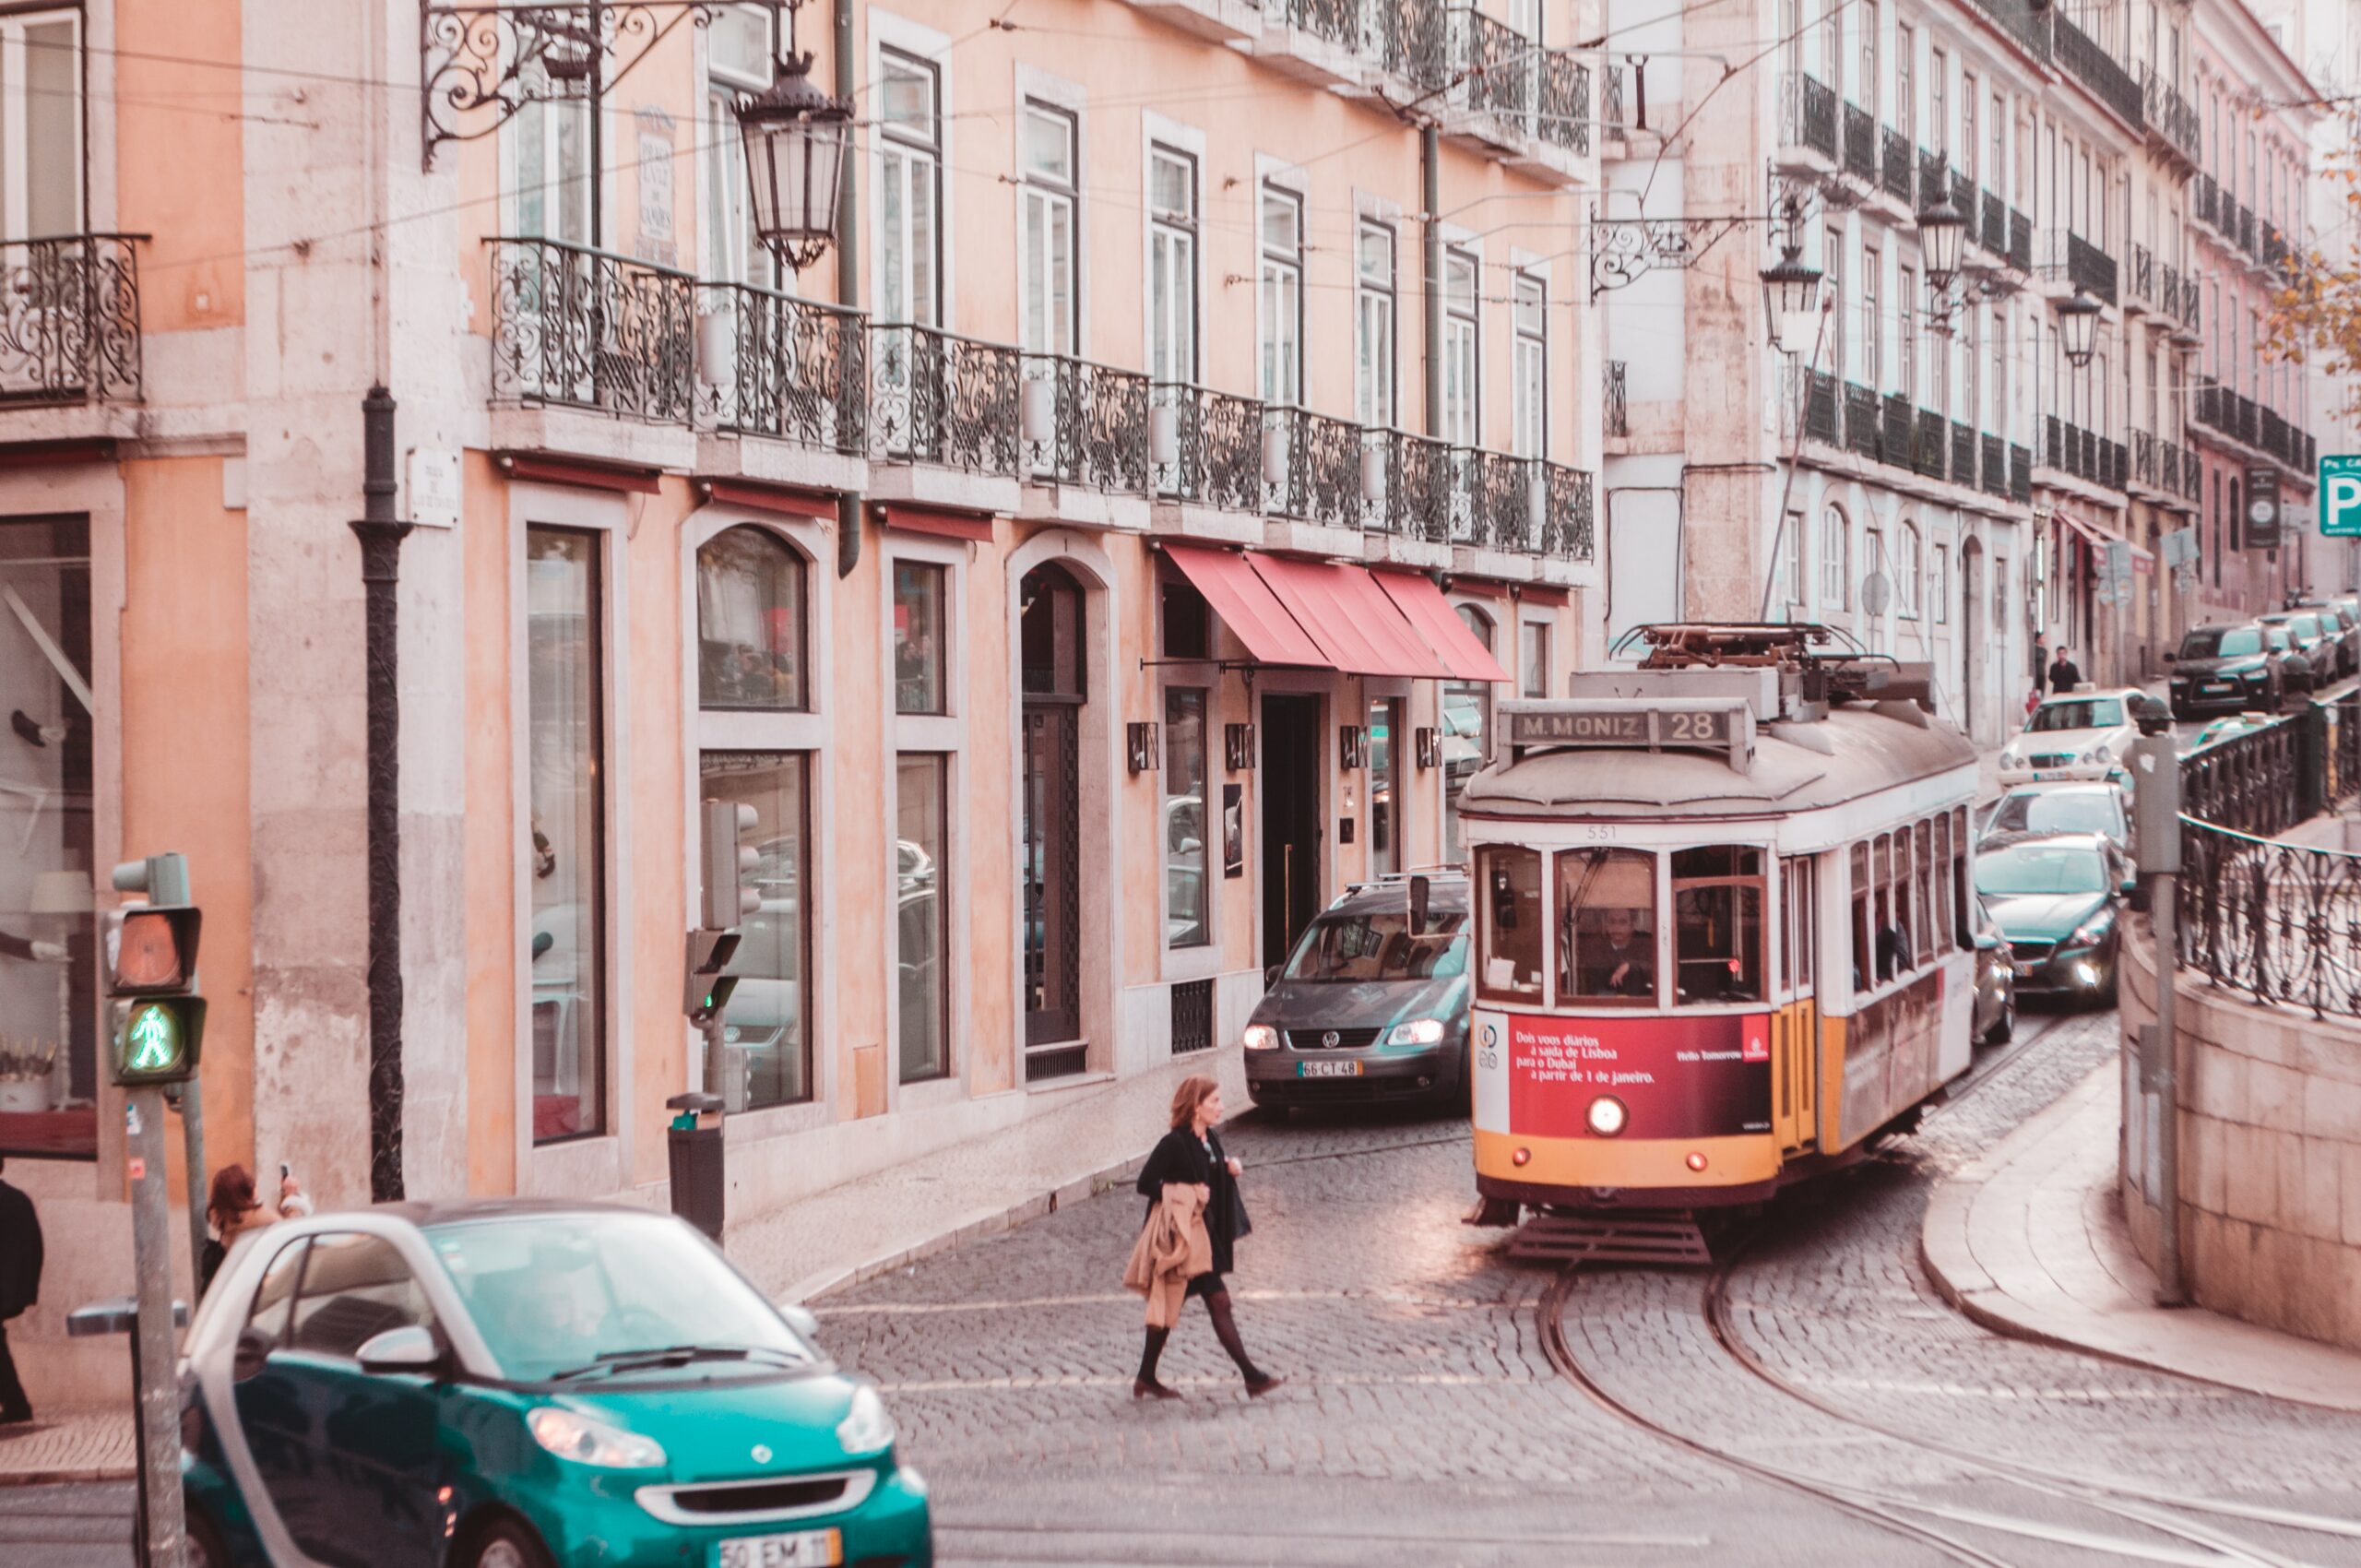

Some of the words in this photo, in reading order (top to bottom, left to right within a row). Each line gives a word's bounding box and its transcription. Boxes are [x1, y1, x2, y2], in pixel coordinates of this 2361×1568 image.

[2328, 478, 2361, 525] P
[1671, 713, 1714, 739] 28
[1587, 826, 1616, 840] 551
[1516, 1031, 1536, 1043] Dois
[1537, 1035, 1560, 1046] voos
[1565, 1047, 1579, 1059] de
[1582, 1047, 1618, 1060] Lisboa
[1516, 1057, 1536, 1069] para
[1537, 1058, 1545, 1068] o
[1547, 1057, 1577, 1070] Dubai
[1538, 1069, 1567, 1083] partir
[1569, 1070, 1584, 1083] de
[1587, 1071, 1592, 1083] 1
[1595, 1070, 1609, 1084] de
[1611, 1071, 1655, 1086] janeiro.
